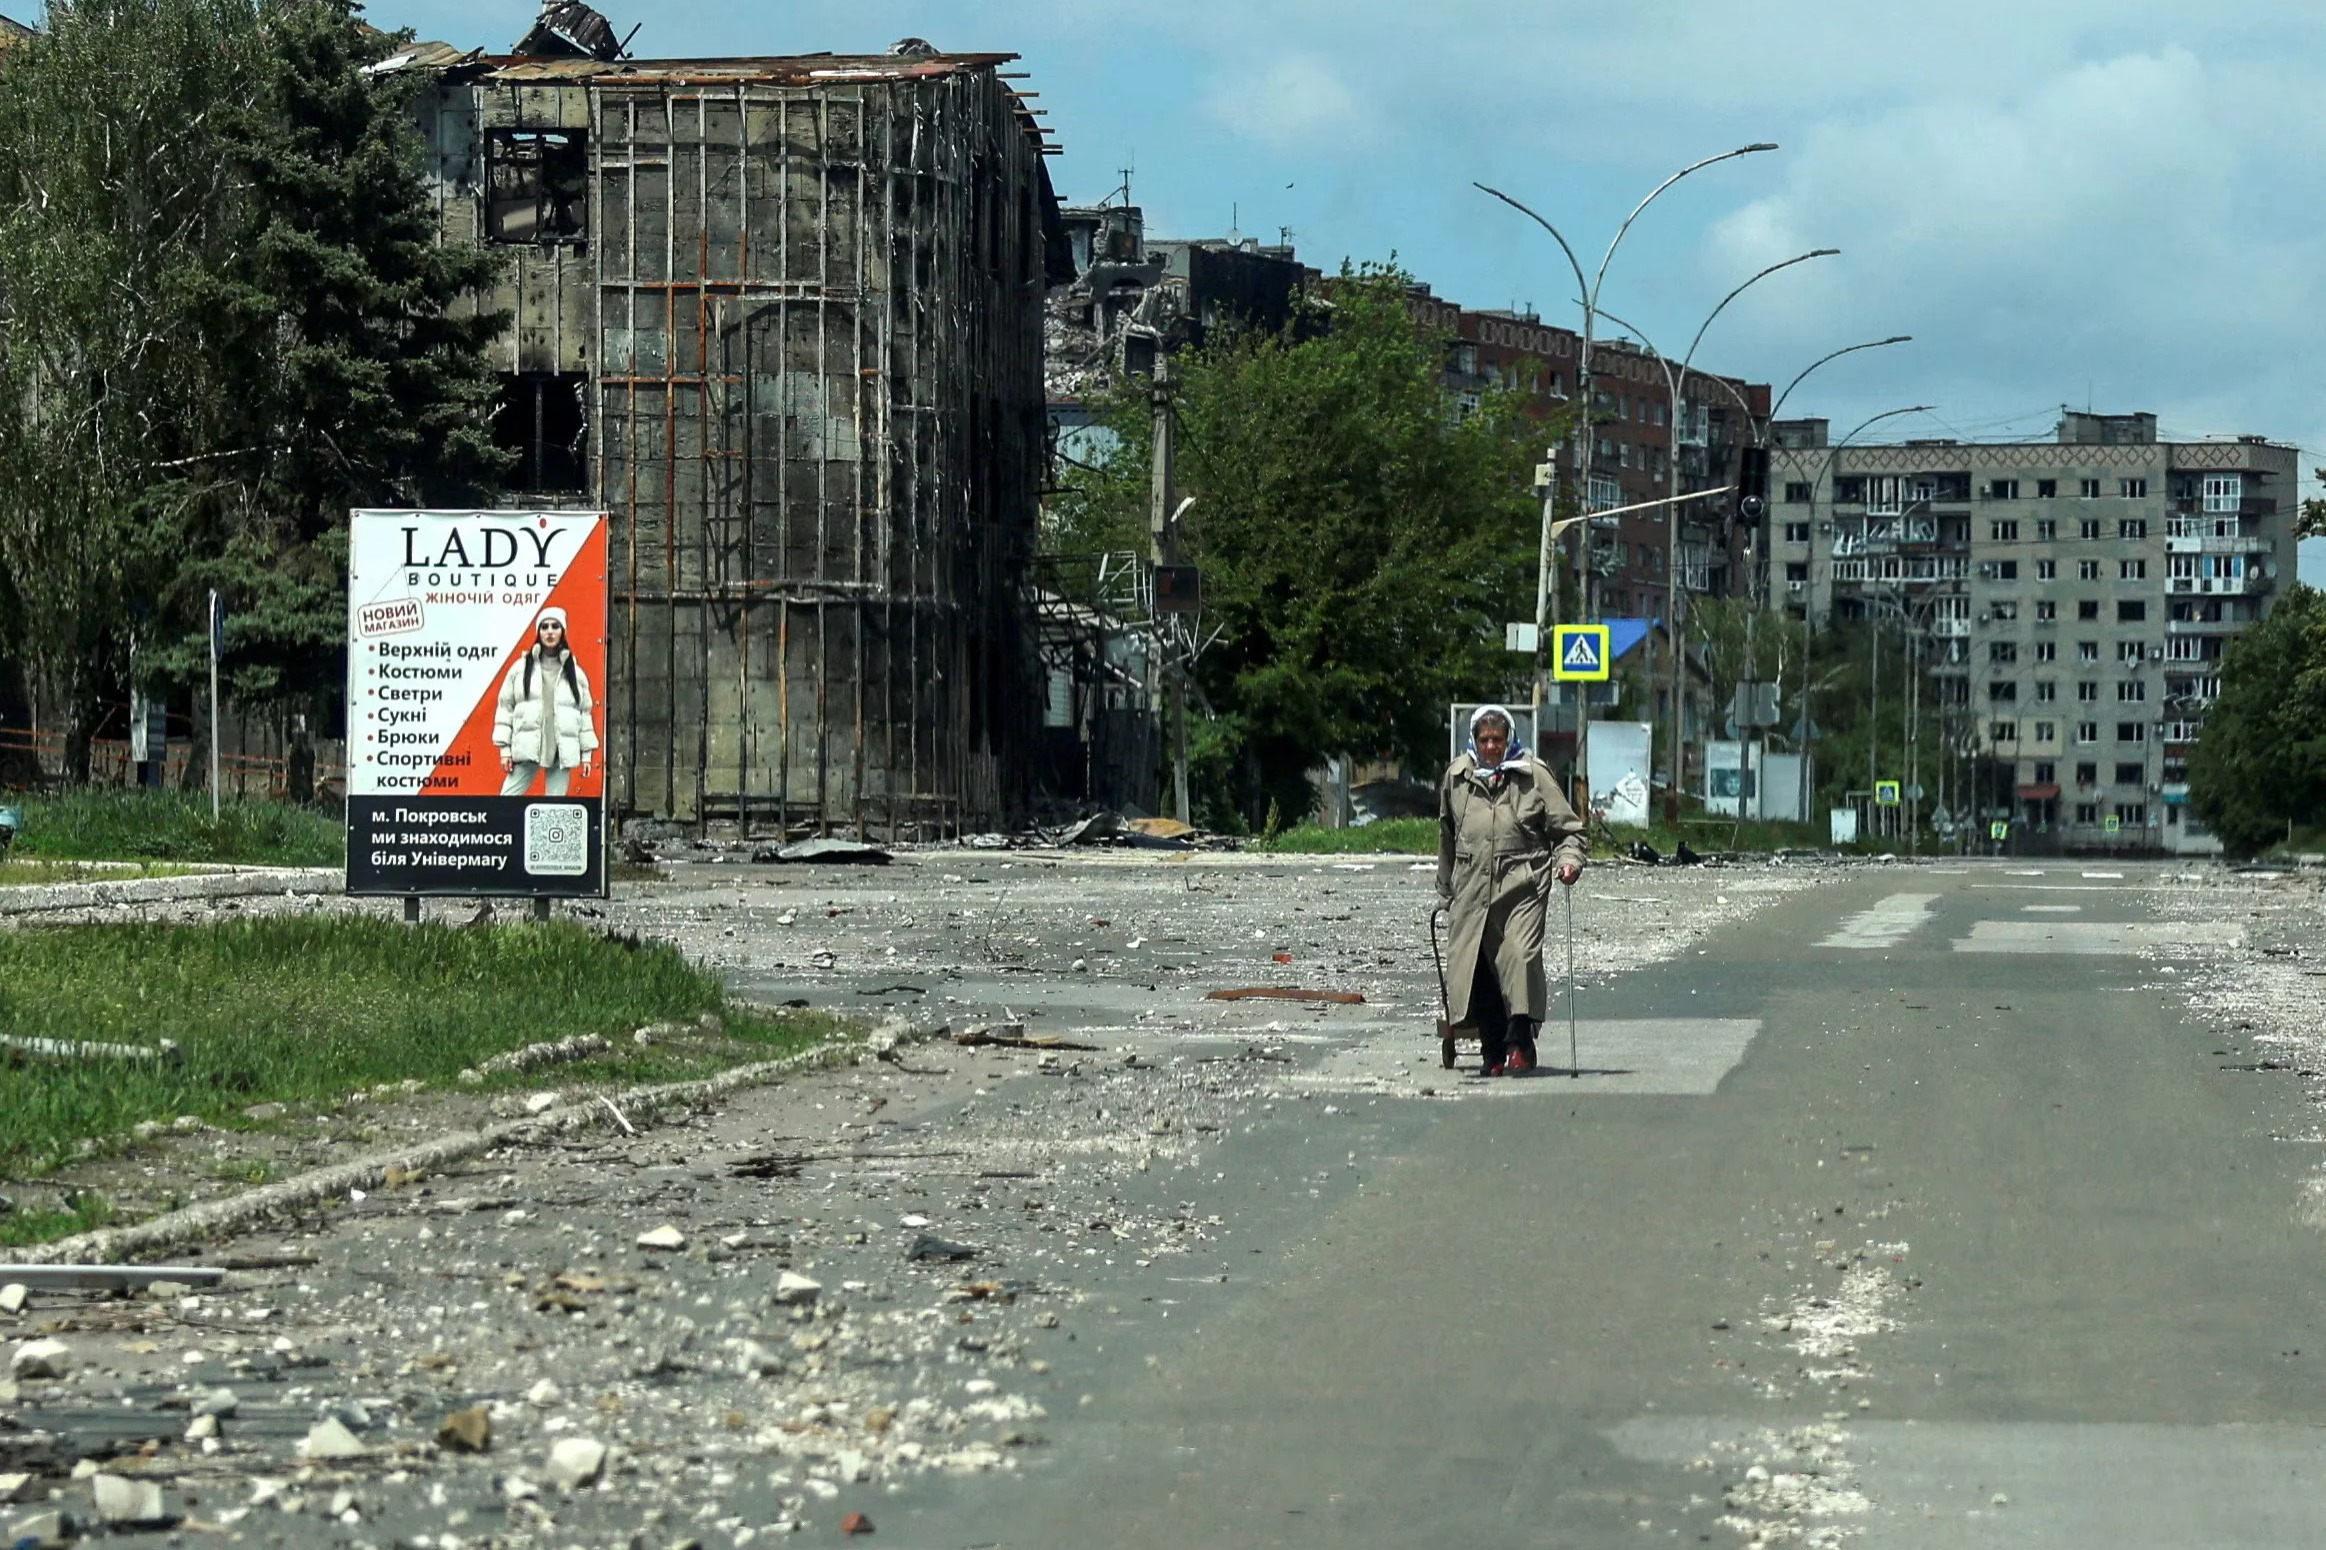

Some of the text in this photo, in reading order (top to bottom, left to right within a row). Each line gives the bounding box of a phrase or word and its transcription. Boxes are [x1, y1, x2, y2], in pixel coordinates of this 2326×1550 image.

[401, 526, 568, 568] LADY
[408, 573, 558, 587] BOUTIQUE
[425, 591, 541, 605] ЖІНОЧІЙ ОДЯГ
[362, 601, 417, 622] НОВИЙ
[364, 616, 419, 633] МАГАЗИН
[379, 641, 499, 660] Верхній одяг
[379, 664, 463, 680] Костюми
[378, 686, 443, 703] Светри
[378, 707, 427, 726] Сукні
[378, 730, 440, 747] Брюки
[377, 751, 471, 769] Спортивні
[377, 777, 459, 788] костюми
[372, 808, 487, 826] м. Покровськ
[371, 833, 513, 848] ми знаходимося
[371, 851, 508, 870] біля Універмагу
